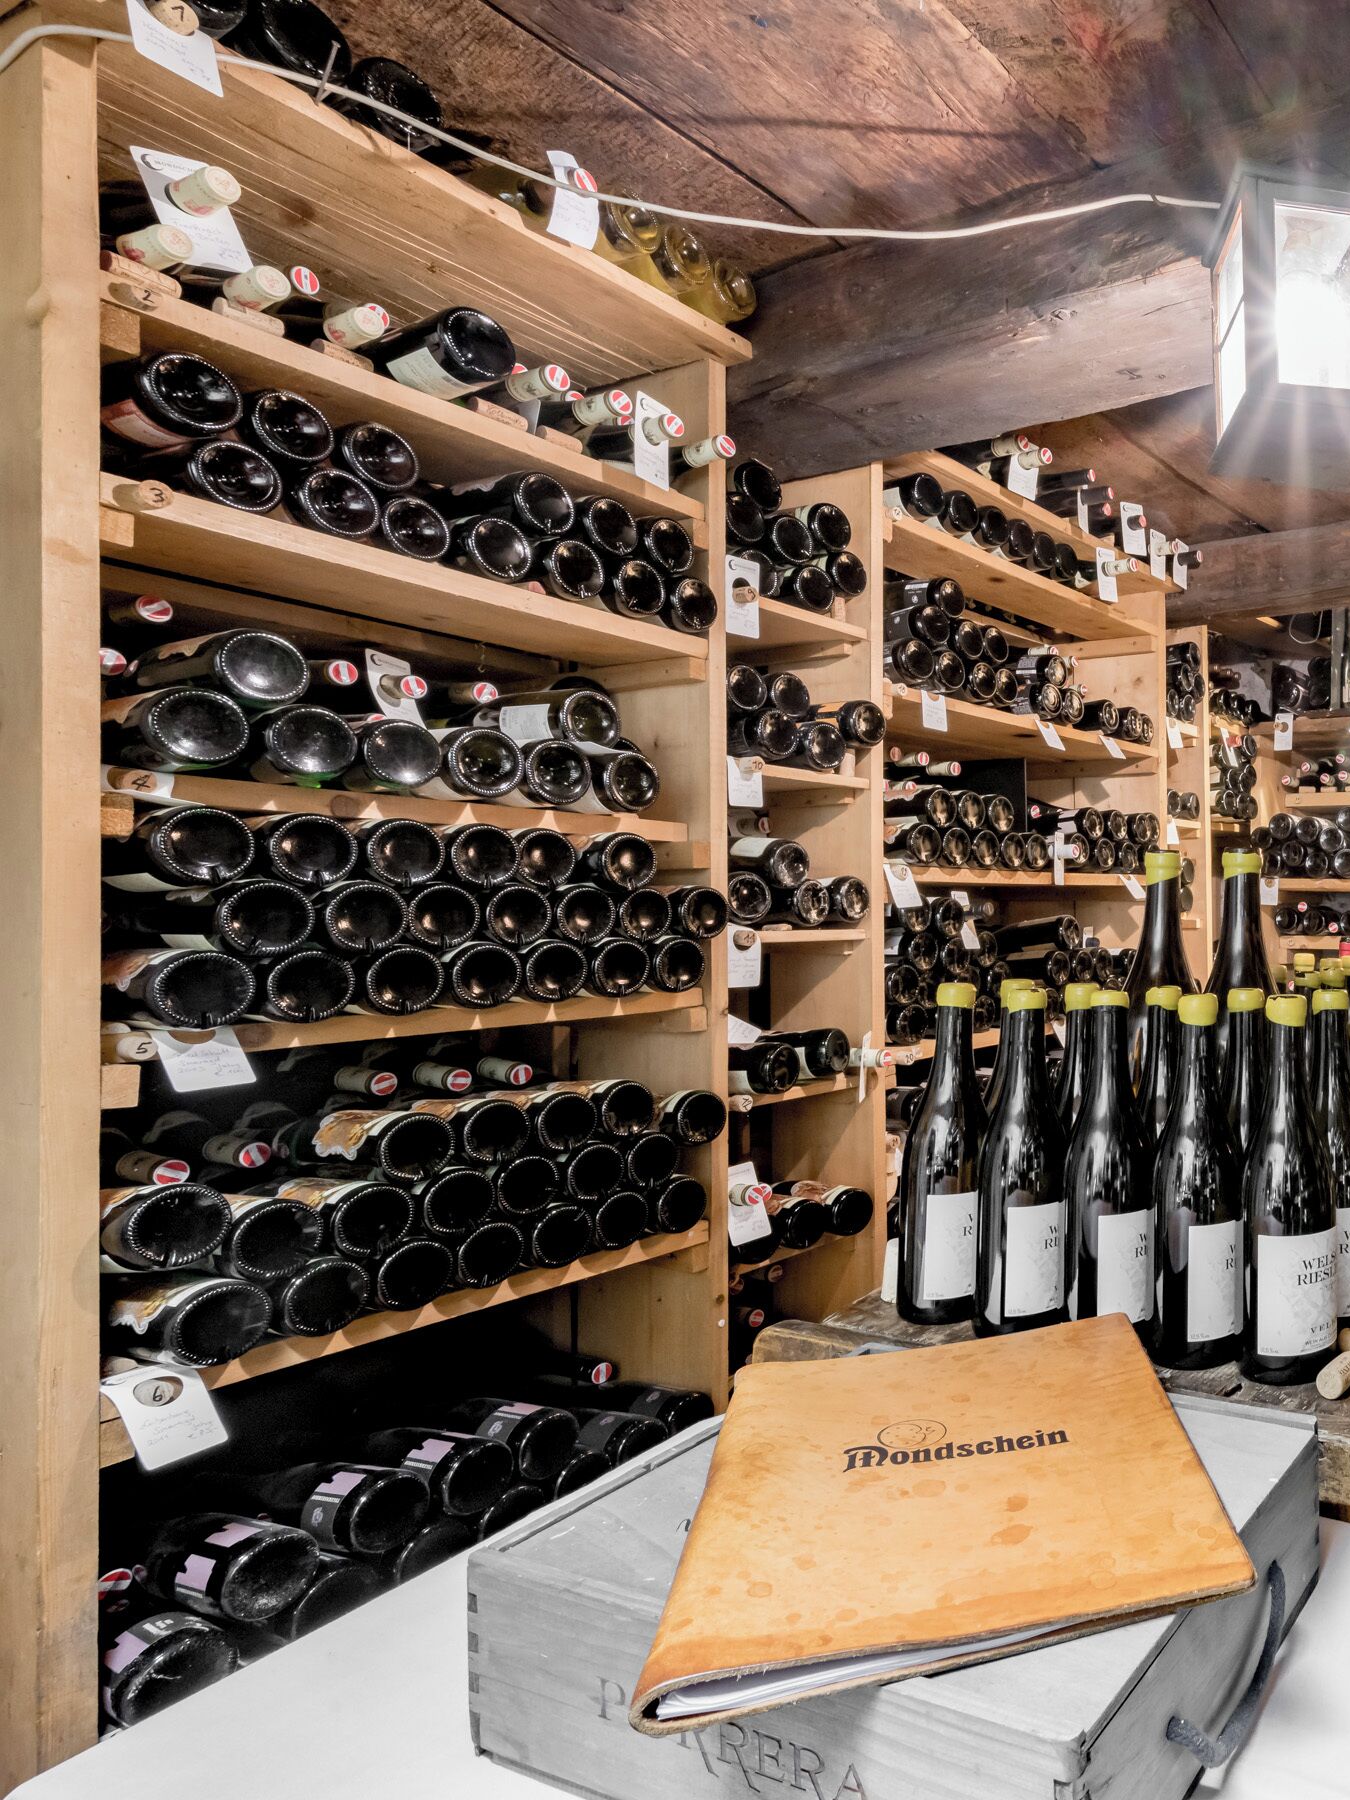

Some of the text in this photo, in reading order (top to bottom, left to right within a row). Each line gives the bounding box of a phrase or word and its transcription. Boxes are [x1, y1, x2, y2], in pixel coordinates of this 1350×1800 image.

[149, 487, 165, 503] 3
[131, 772, 153, 791] 4
[136, 1041, 153, 1055] 5
[152, 1385, 162, 1402] 6
[843, 1429, 1070, 1473] Mondschein
